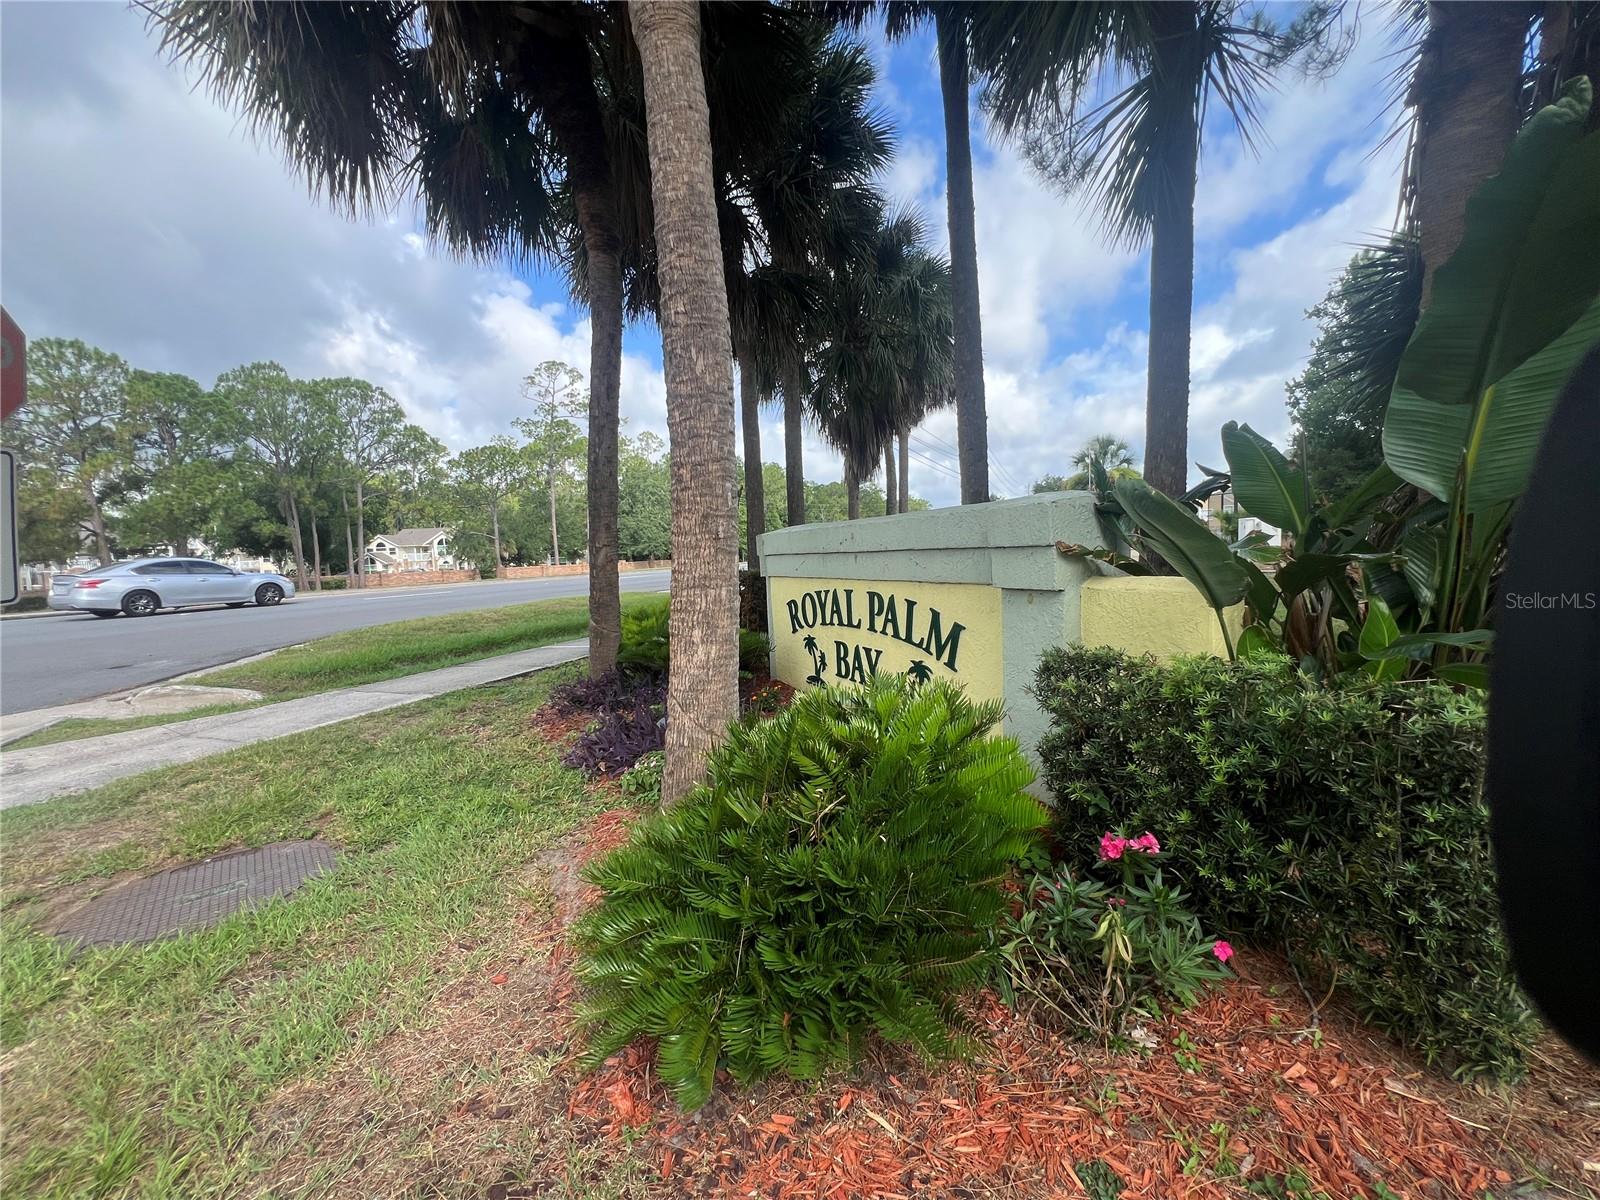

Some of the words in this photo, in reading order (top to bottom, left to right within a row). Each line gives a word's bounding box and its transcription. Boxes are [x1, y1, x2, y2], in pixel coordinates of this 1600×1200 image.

[786, 588, 862, 634] ROYAL
[866, 591, 966, 672] PALM
[834, 640, 883, 685] BAY
